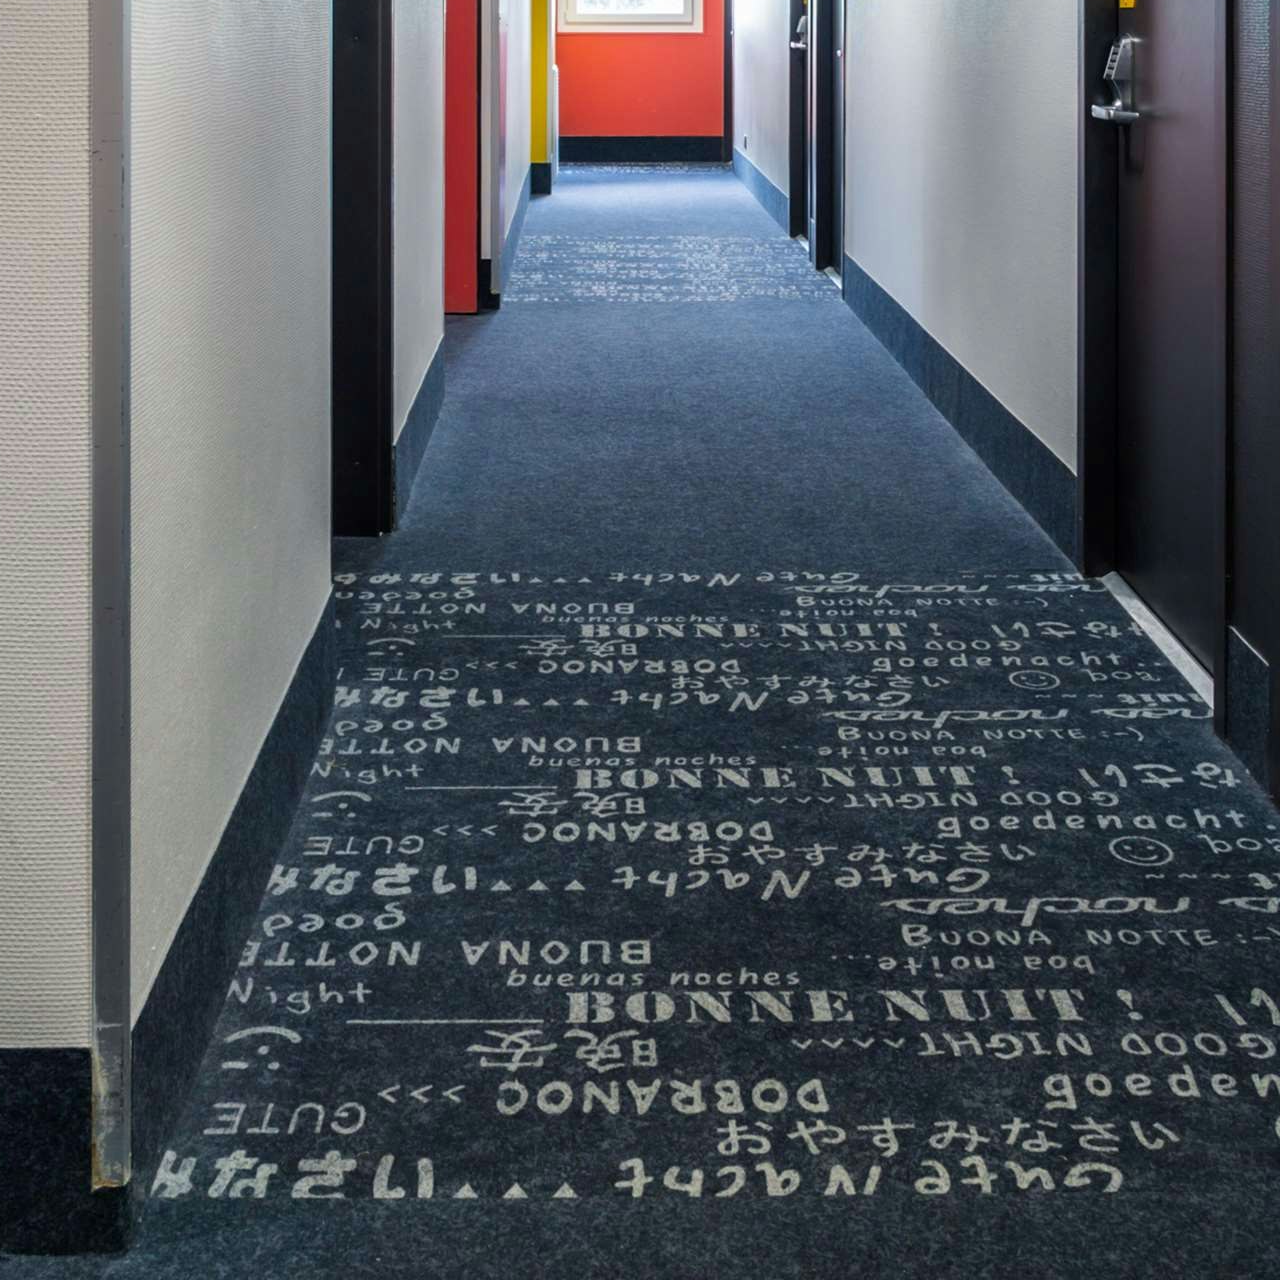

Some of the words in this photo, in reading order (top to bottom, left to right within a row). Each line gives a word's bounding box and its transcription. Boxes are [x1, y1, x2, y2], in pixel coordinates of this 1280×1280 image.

[361, 603, 486, 614] NOTTE
[512, 603, 634, 614] BUONA
[796, 596, 892, 607] BUONA
[916, 598, 998, 606] NOTTE
[582, 624, 760, 637] BONNE
[779, 623, 907, 636] NUIT
[799, 641, 906, 652] NIGHT
[925, 640, 1021, 651] GOOD
[364, 668, 459, 681] GUTE
[539, 659, 740, 674] DOBRANOC
[611, 690, 768, 712] Nacht
[787, 688, 911, 707] Gute
[838, 727, 955, 740] BUONA
[983, 729, 1085, 739] NOTTE
[319, 738, 460, 755] NOTTE
[492, 737, 640, 753] BUONA
[529, 755, 638, 766] buenas
[655, 754, 756, 765] noches
[310, 761, 423, 784] Night
[576, 768, 796, 789] BONNE
[817, 766, 975, 787] NUIT
[844, 792, 978, 809] NIGHT
[1000, 791, 1119, 806] GOOD
[523, 821, 773, 842] DOBRANOC
[304, 835, 424, 855] GUTE
[689, 842, 1036, 866] おやすみなさい
[612, 866, 810, 900] Nacht
[835, 864, 990, 892] Gute
[902, 924, 1051, 949] BUONA
[1086, 929, 1218, 946] NOTTE
[239, 941, 421, 966] NOTTE
[462, 940, 651, 965] BUONA
[1024, 956, 1095, 974] boa
[507, 969, 643, 987] buenas
[670, 968, 799, 985] noches
[227, 977, 372, 1014] Night
[566, 990, 853, 1023] BONNE
[878, 989, 1084, 1021] NUIT
[919, 1032, 1092, 1059] NIGHT
[1121, 1033, 1276, 1059] GOOD
[497, 1079, 829, 1115] DOBRANOC
[204, 1102, 366, 1134] GUTE
[717, 1117, 1180, 1157] おやすみなさい
[915, 1156, 1123, 1194] Gute
